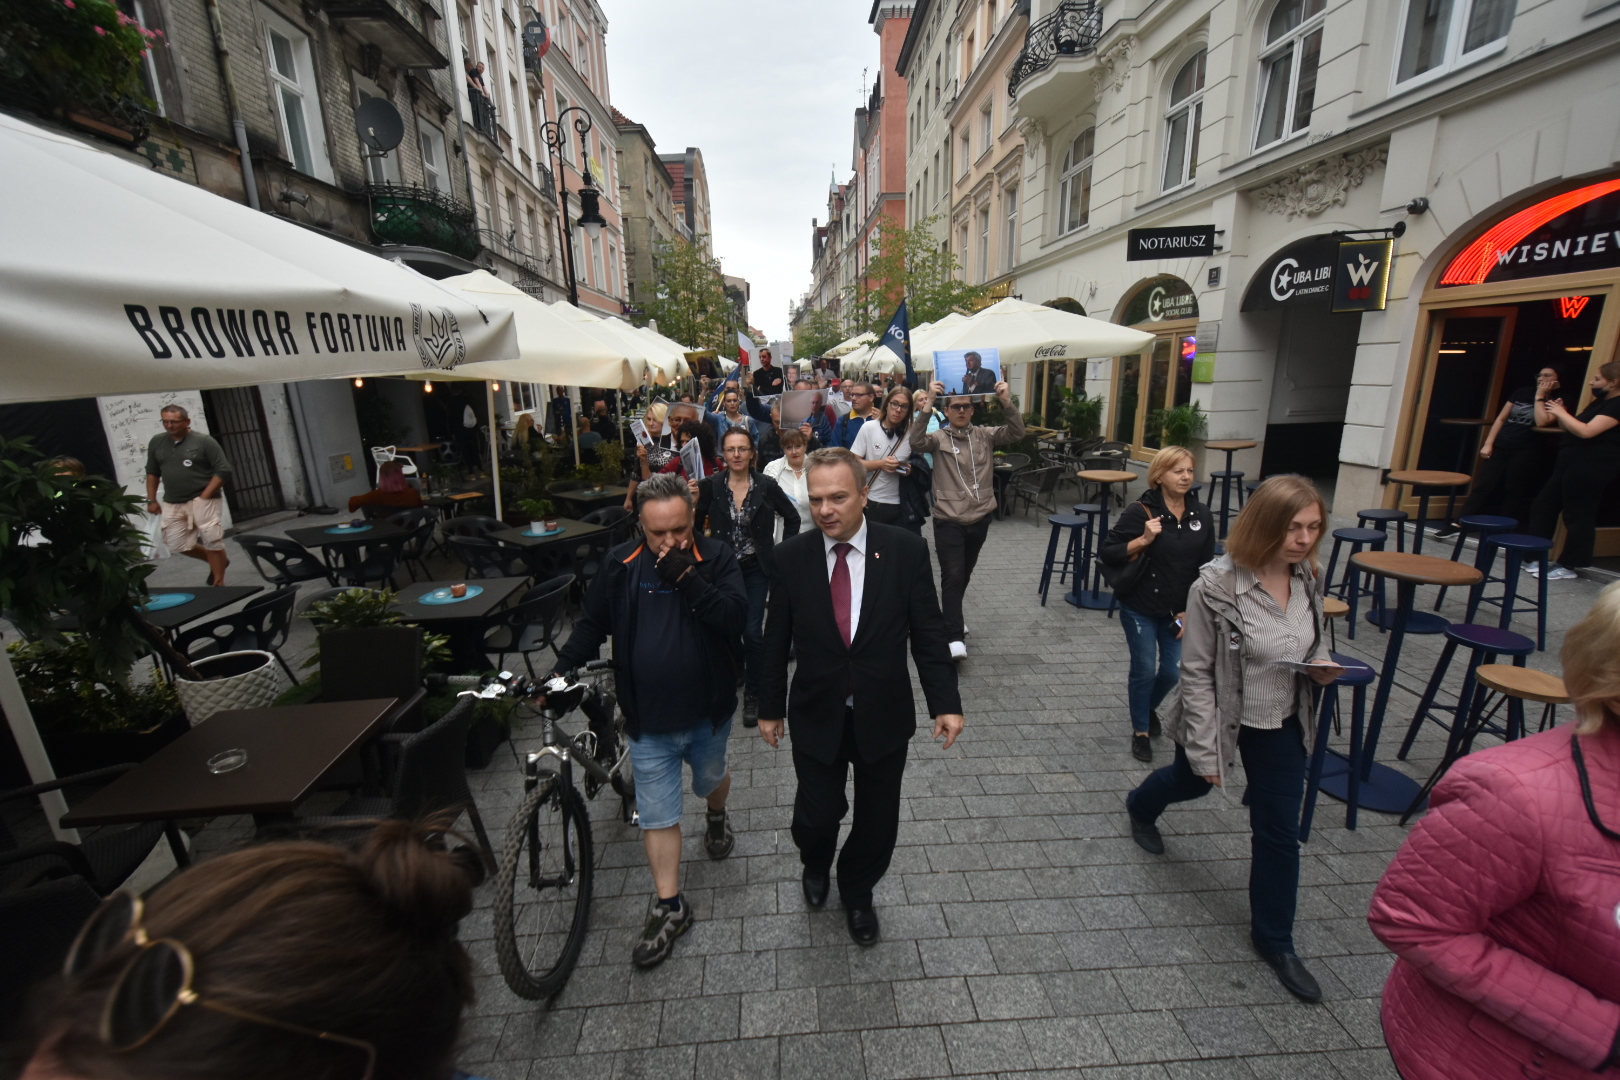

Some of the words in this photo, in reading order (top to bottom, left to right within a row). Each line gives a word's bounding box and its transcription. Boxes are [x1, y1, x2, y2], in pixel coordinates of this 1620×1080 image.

[1139, 235, 1206, 250] NOTARIUSZ
[1497, 231, 1620, 266] WISNIE
[1314, 266, 1332, 280] LIB
[1176, 294, 1194, 306] LIBRE
[1180, 306, 1193, 314] CLUB
[123, 304, 299, 359] BROWAR
[306, 311, 407, 354] FORTUNA
[887, 324, 905, 344] KO
[1034, 344, 1068, 358] Coca-Cola
